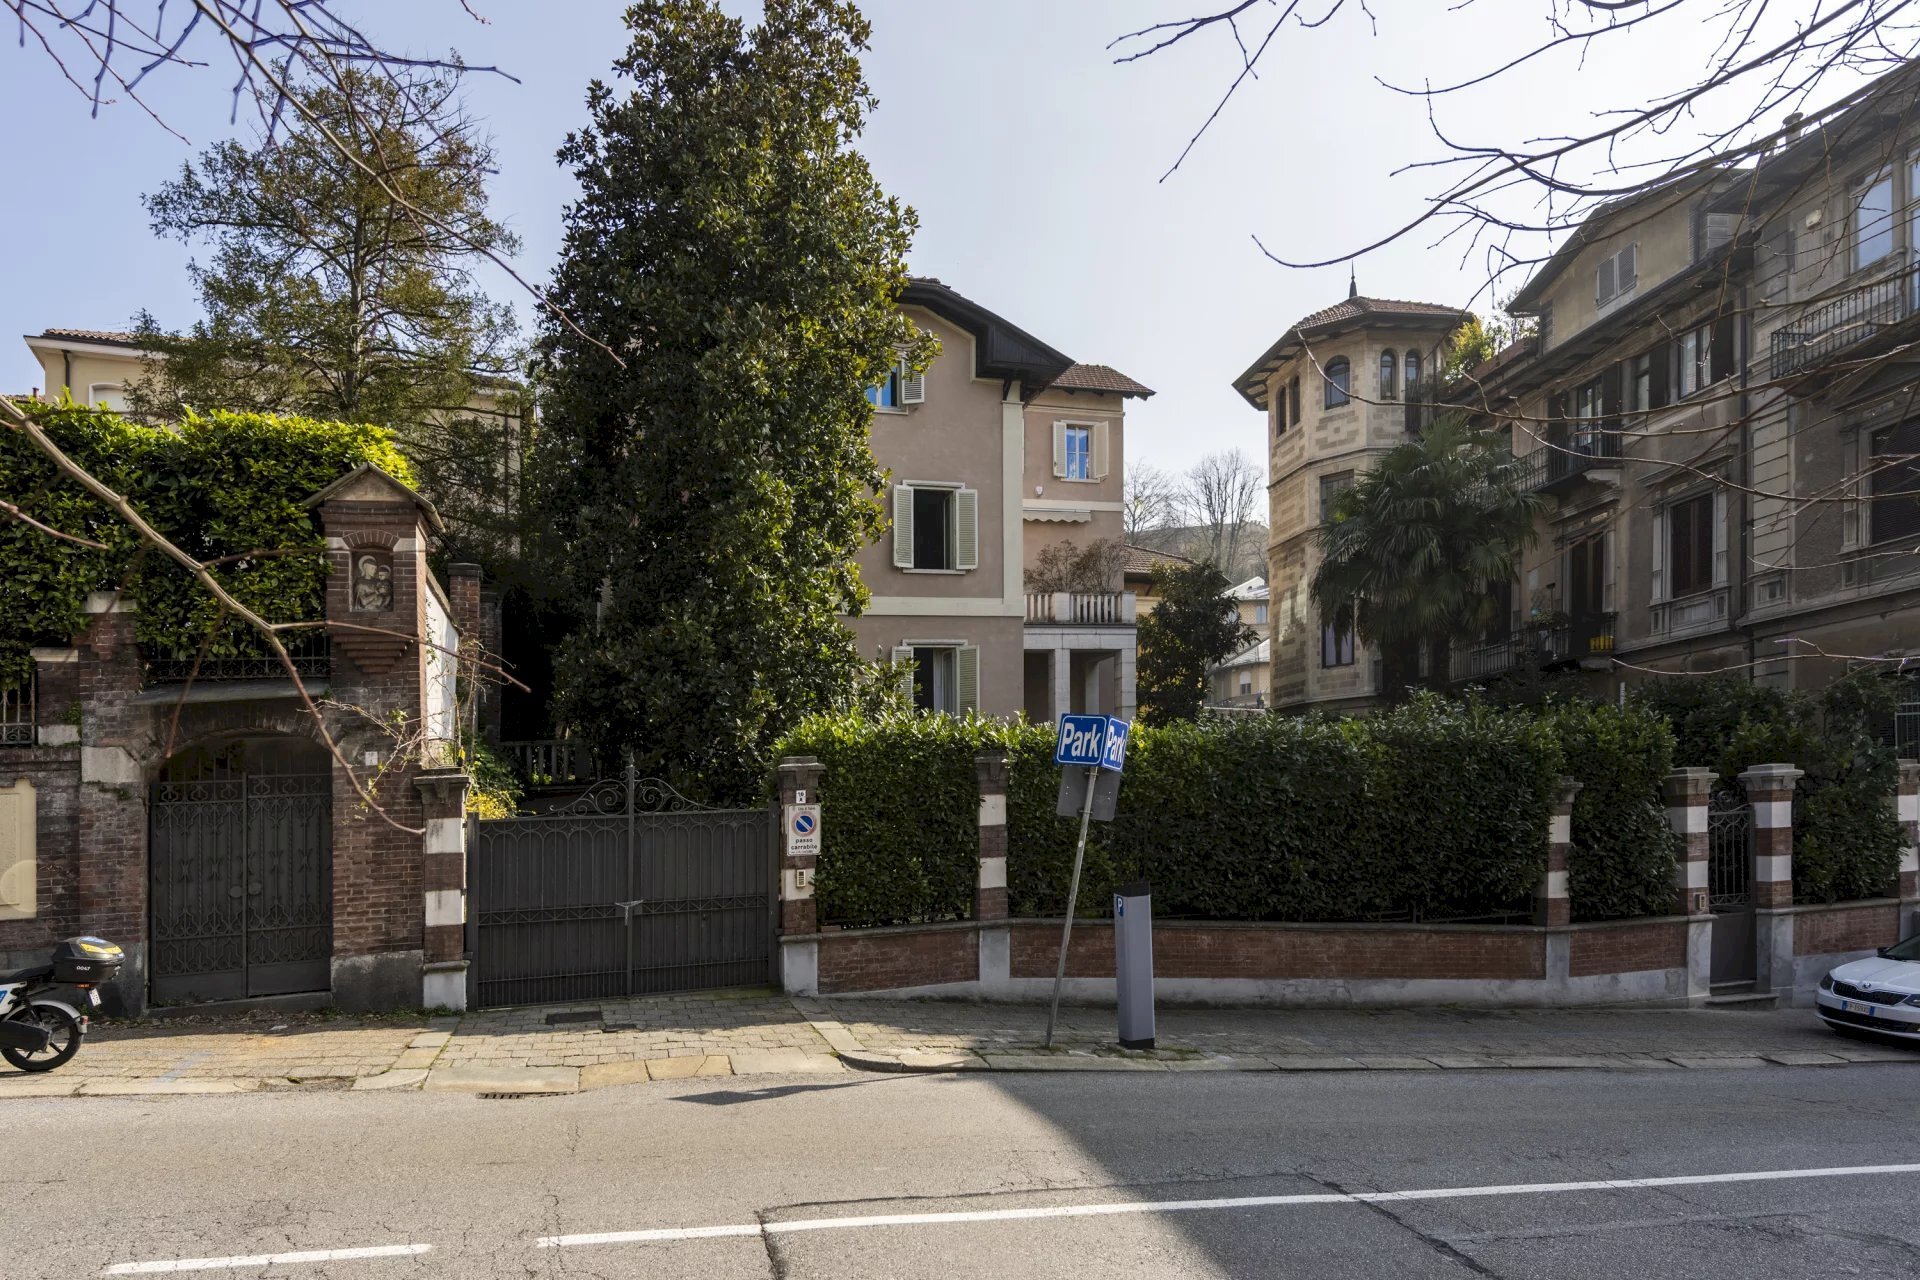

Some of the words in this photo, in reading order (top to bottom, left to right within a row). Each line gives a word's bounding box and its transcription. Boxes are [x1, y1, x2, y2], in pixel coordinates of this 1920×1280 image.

[1060, 722, 1101, 758] Park
[1104, 725, 1126, 763] Park
[1117, 897, 1123, 913] P
